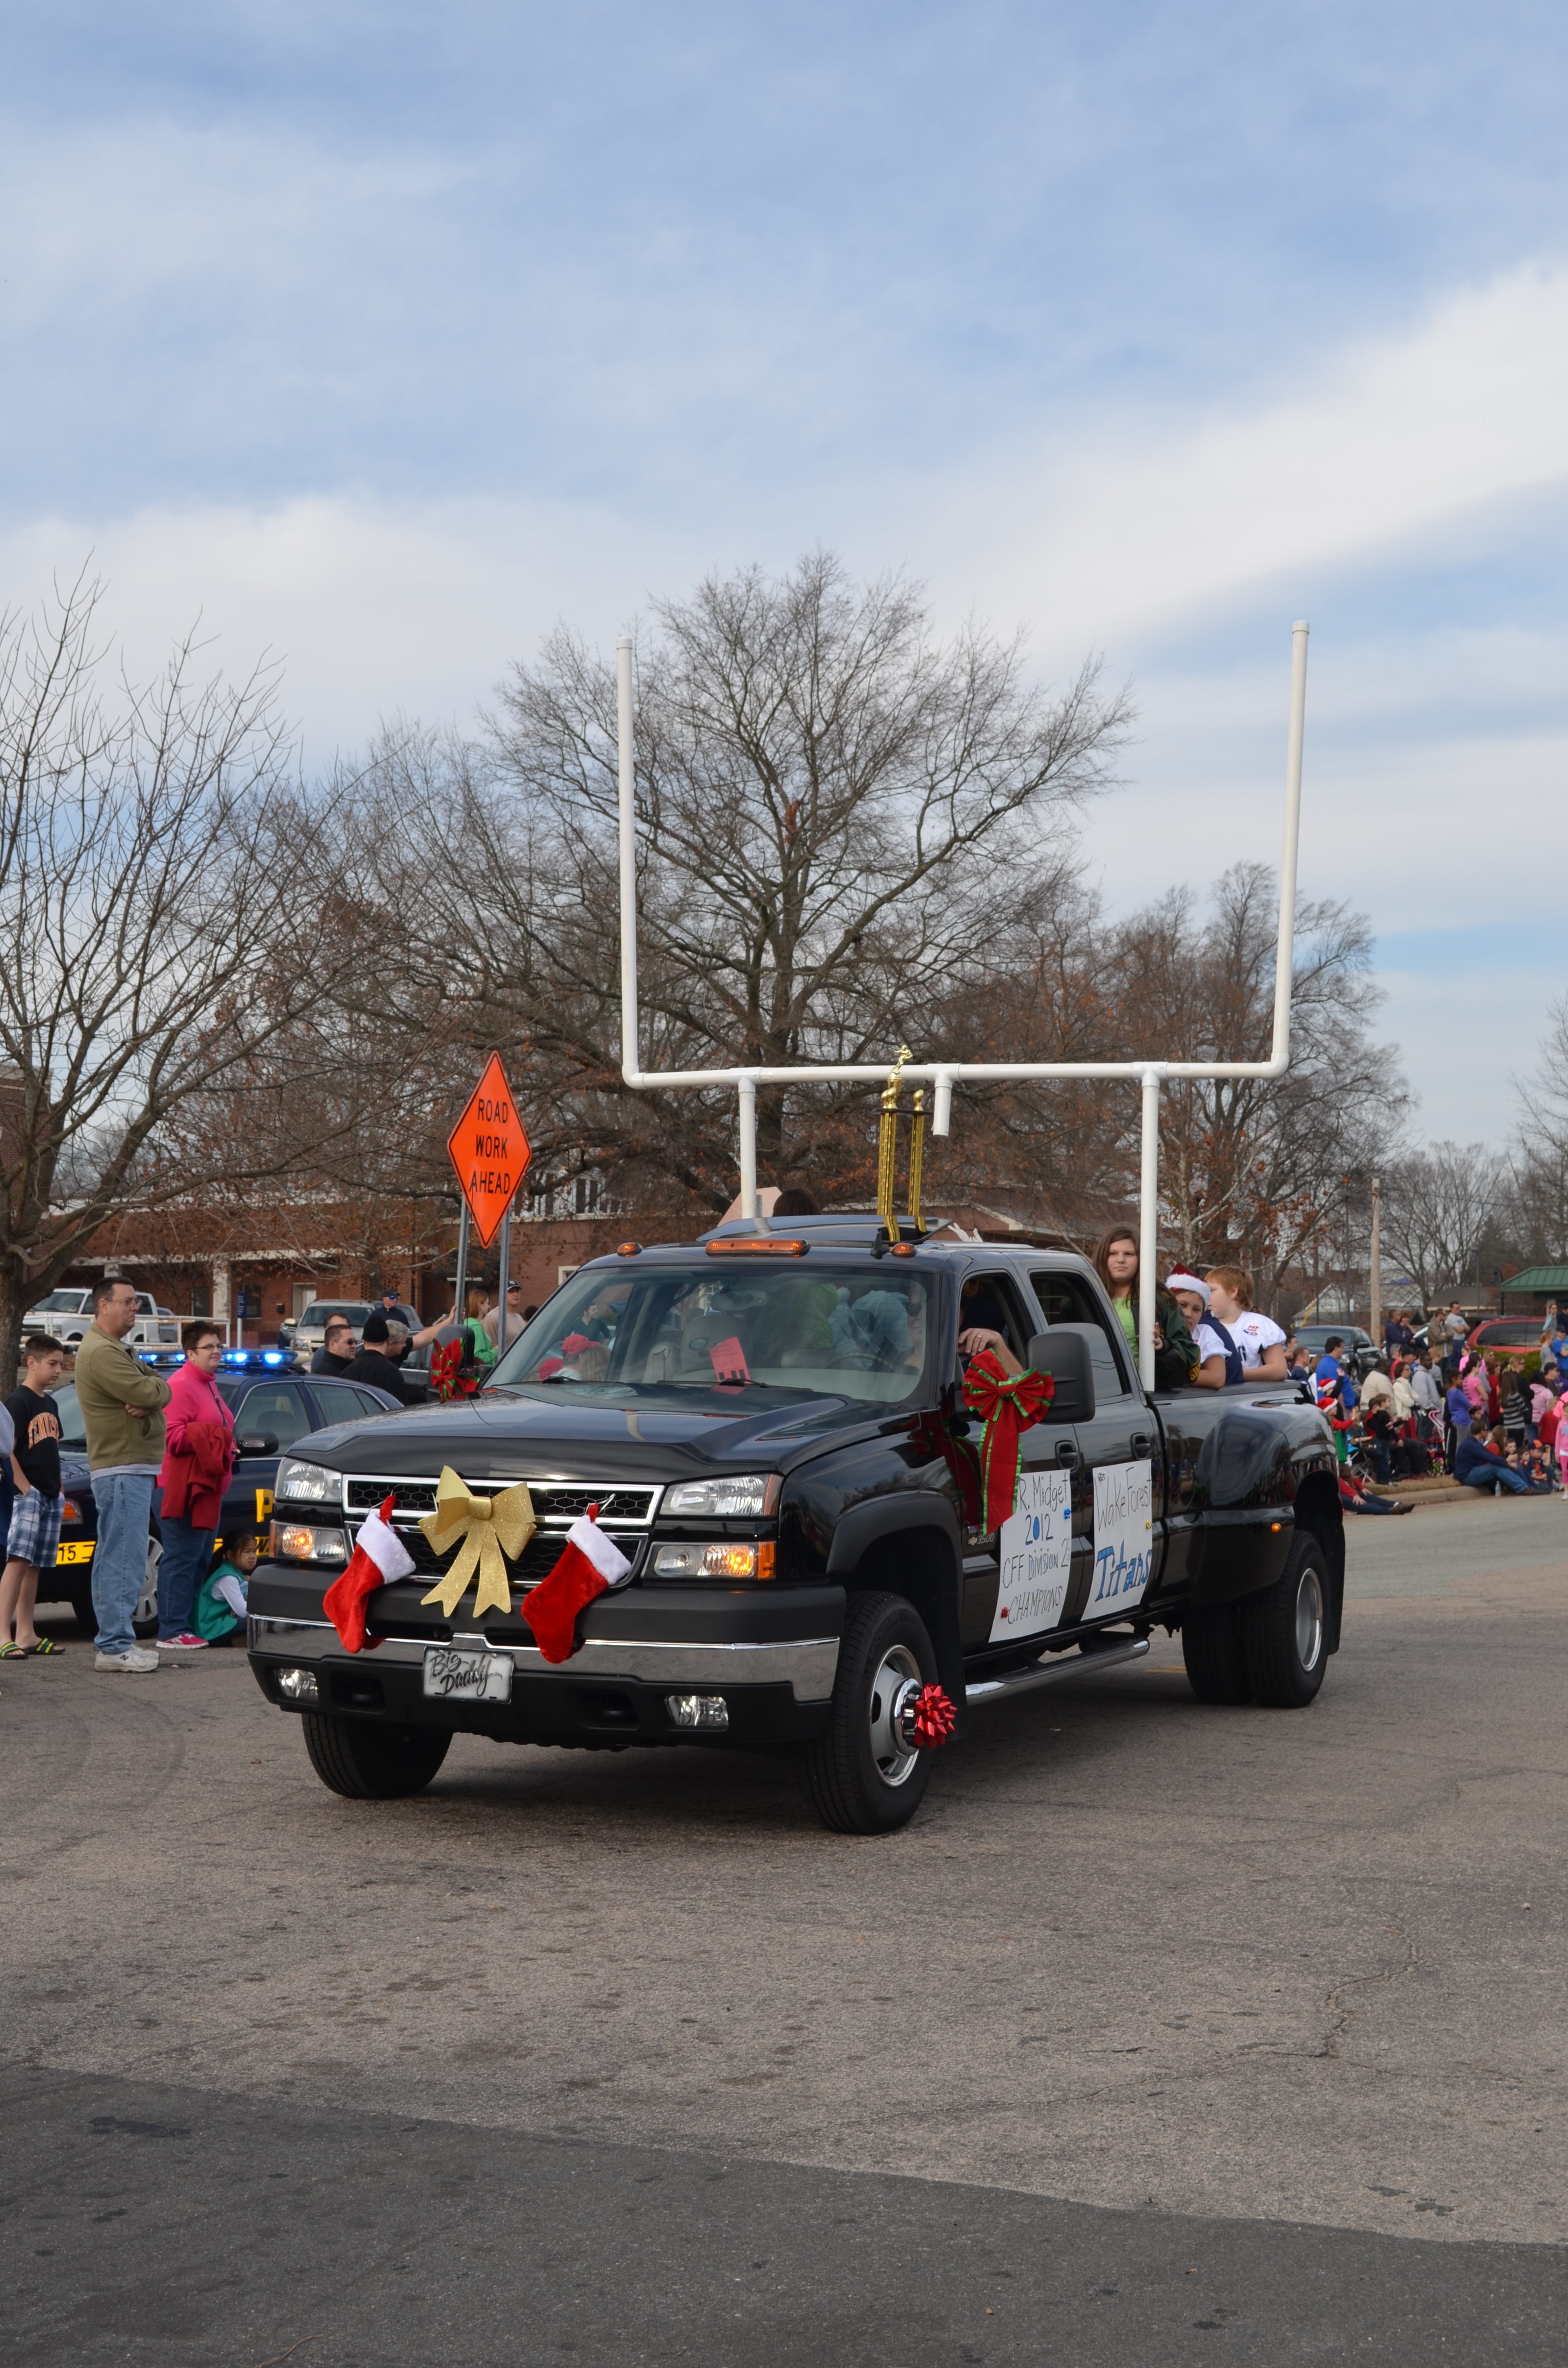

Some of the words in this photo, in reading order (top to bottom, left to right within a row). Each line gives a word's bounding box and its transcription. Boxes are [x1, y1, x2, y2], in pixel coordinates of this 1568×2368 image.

[478, 1099, 508, 1123] ROAD
[476, 1135, 508, 1159] WORK
[469, 1171, 510, 1195] AHEAD
[1017, 1477, 1030, 1511] R.
[1032, 1472, 1068, 1512] Midget
[1094, 1475, 1126, 1531] Wake
[1126, 1467, 1151, 1516] Forest
[1025, 1513, 1054, 1545] 2012
[1003, 1554, 1024, 1588] CFF
[1095, 1539, 1152, 1602] Titans
[1007, 1586, 1063, 1624] CHAMPIONS
[429, 1651, 468, 1677] Big
[440, 1655, 502, 1697] Daddy
